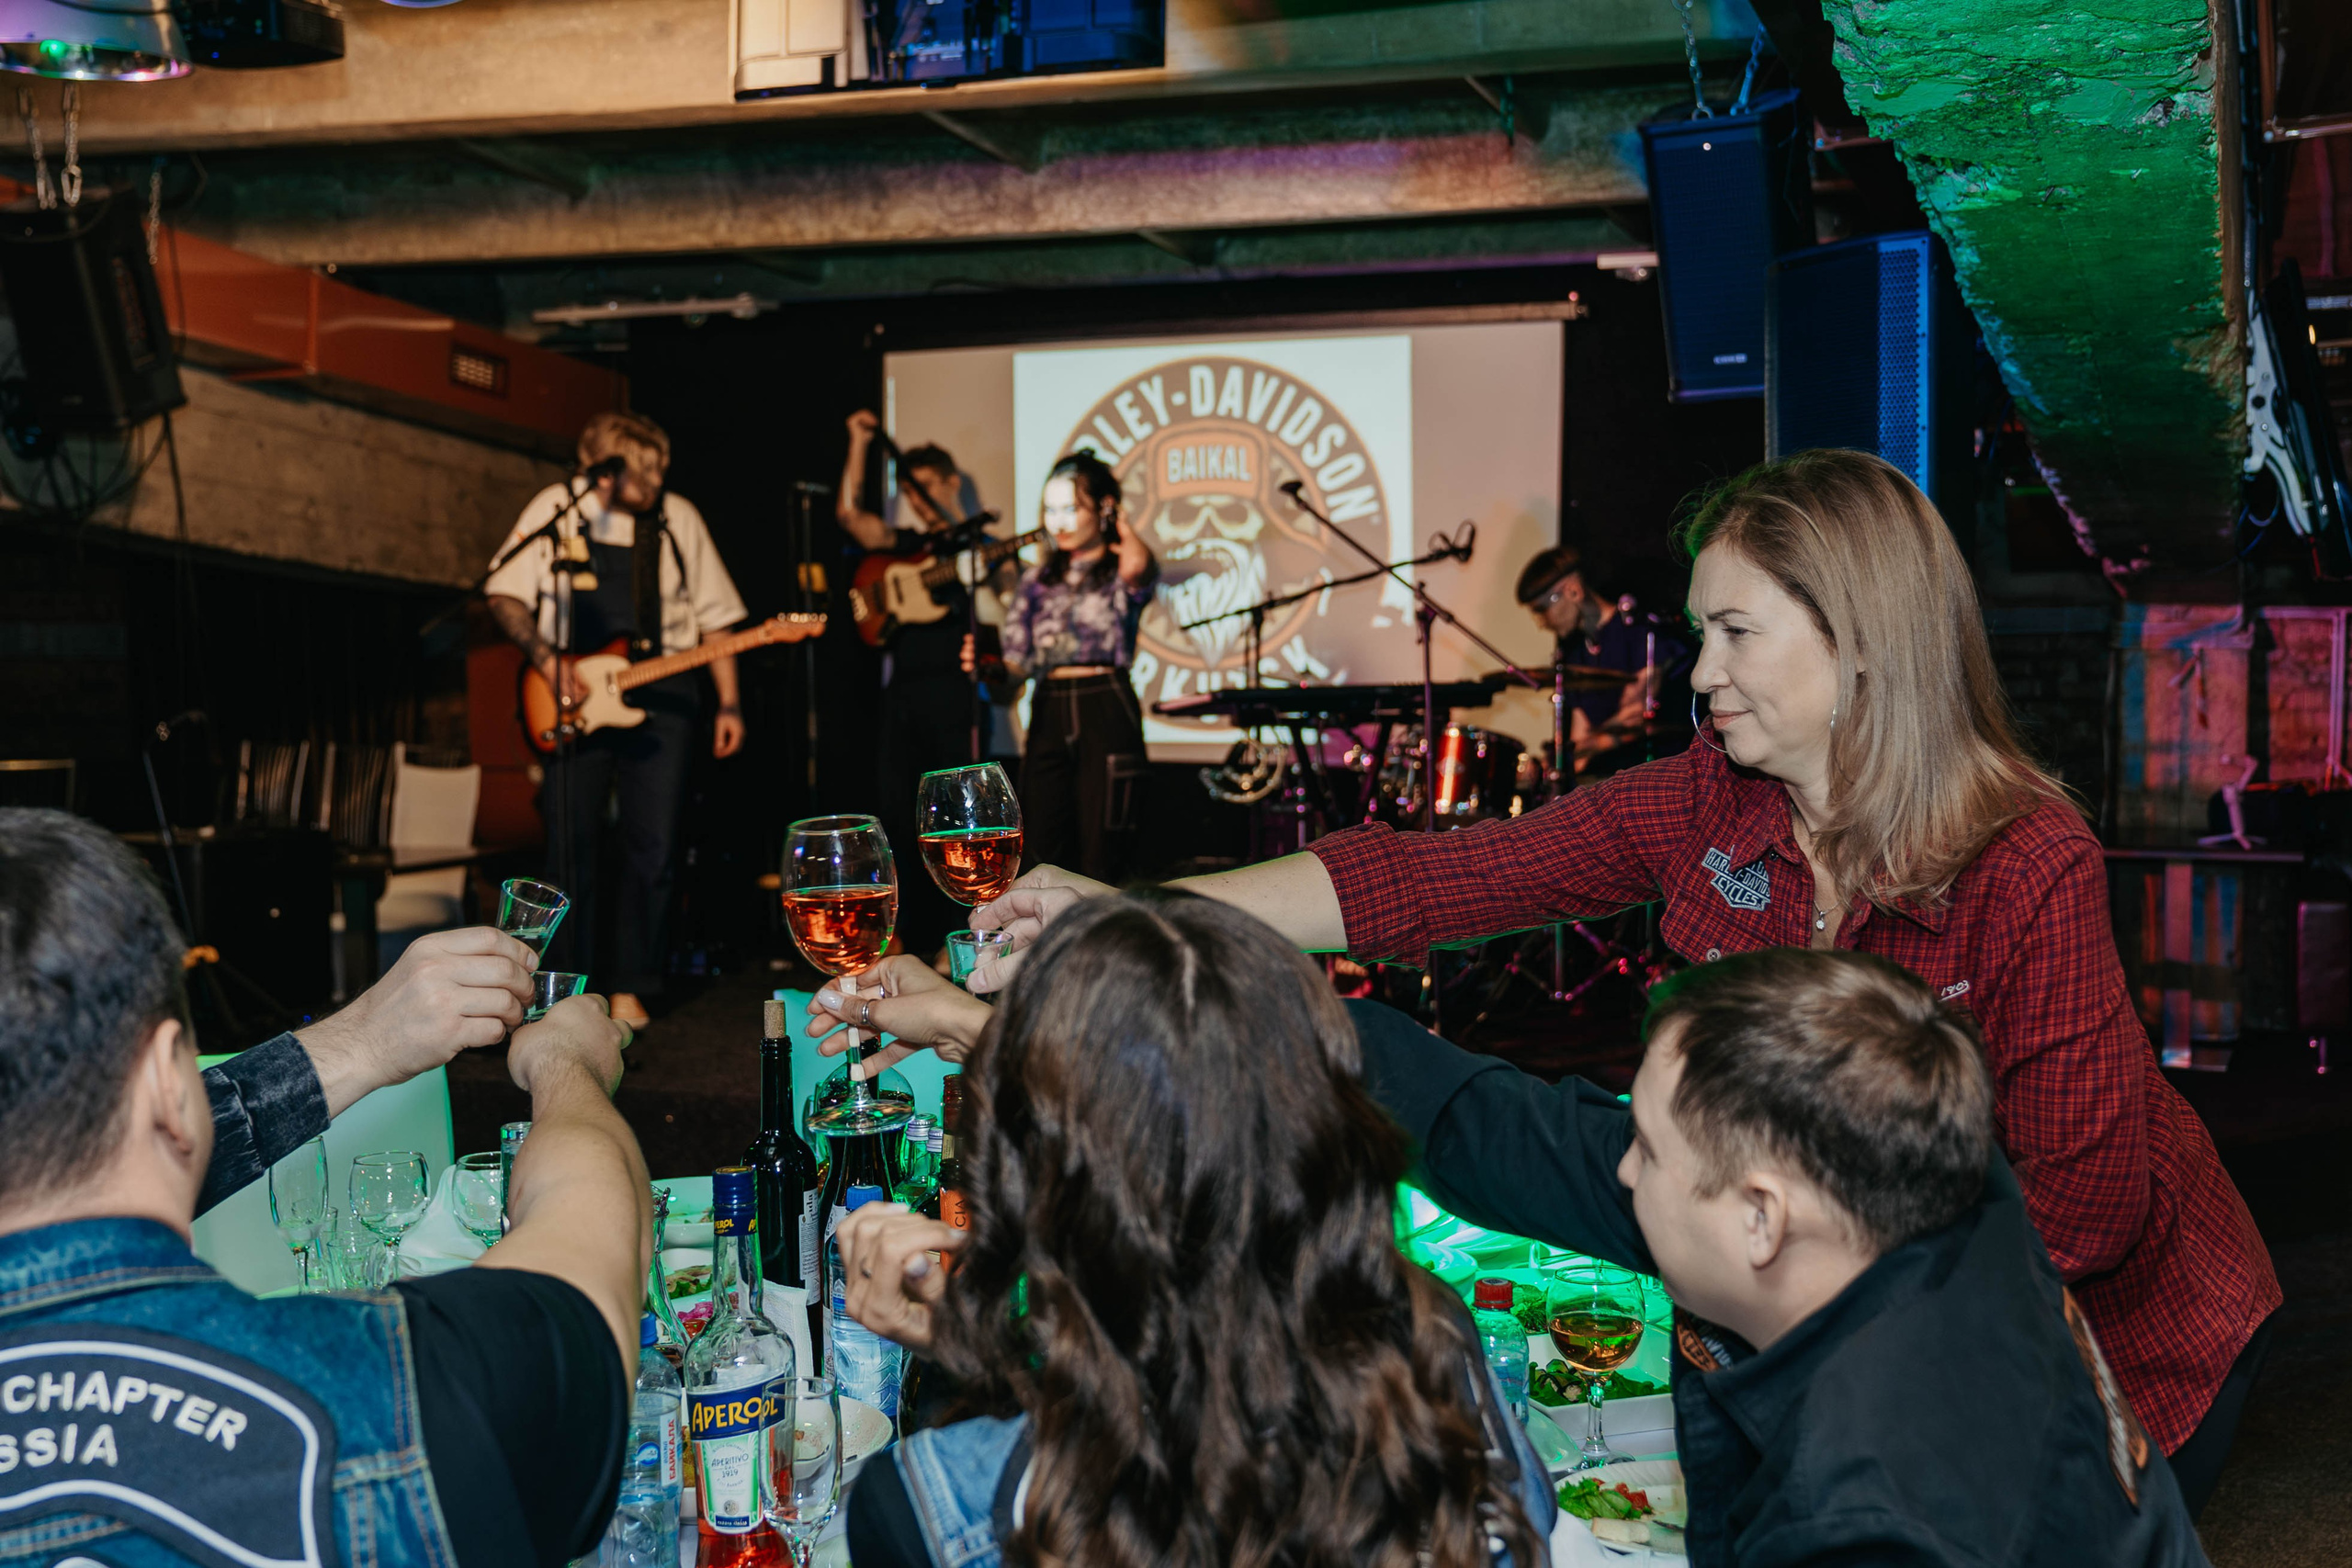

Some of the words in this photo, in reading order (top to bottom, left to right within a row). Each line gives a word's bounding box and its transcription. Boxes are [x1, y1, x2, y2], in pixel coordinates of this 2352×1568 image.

[1168, 445, 1252, 483] BAIKAL
[1717, 877, 1759, 906] CYCLES
[1940, 979, 1970, 998] 1903
[2, 1371, 248, 1451] CHAPTER
[692, 1396, 778, 1433] APEROL
[668, 1418, 677, 1481] БАЙКАЛА
[711, 1452, 750, 1467] APERITIVO
[721, 1469, 739, 1478] 1919
